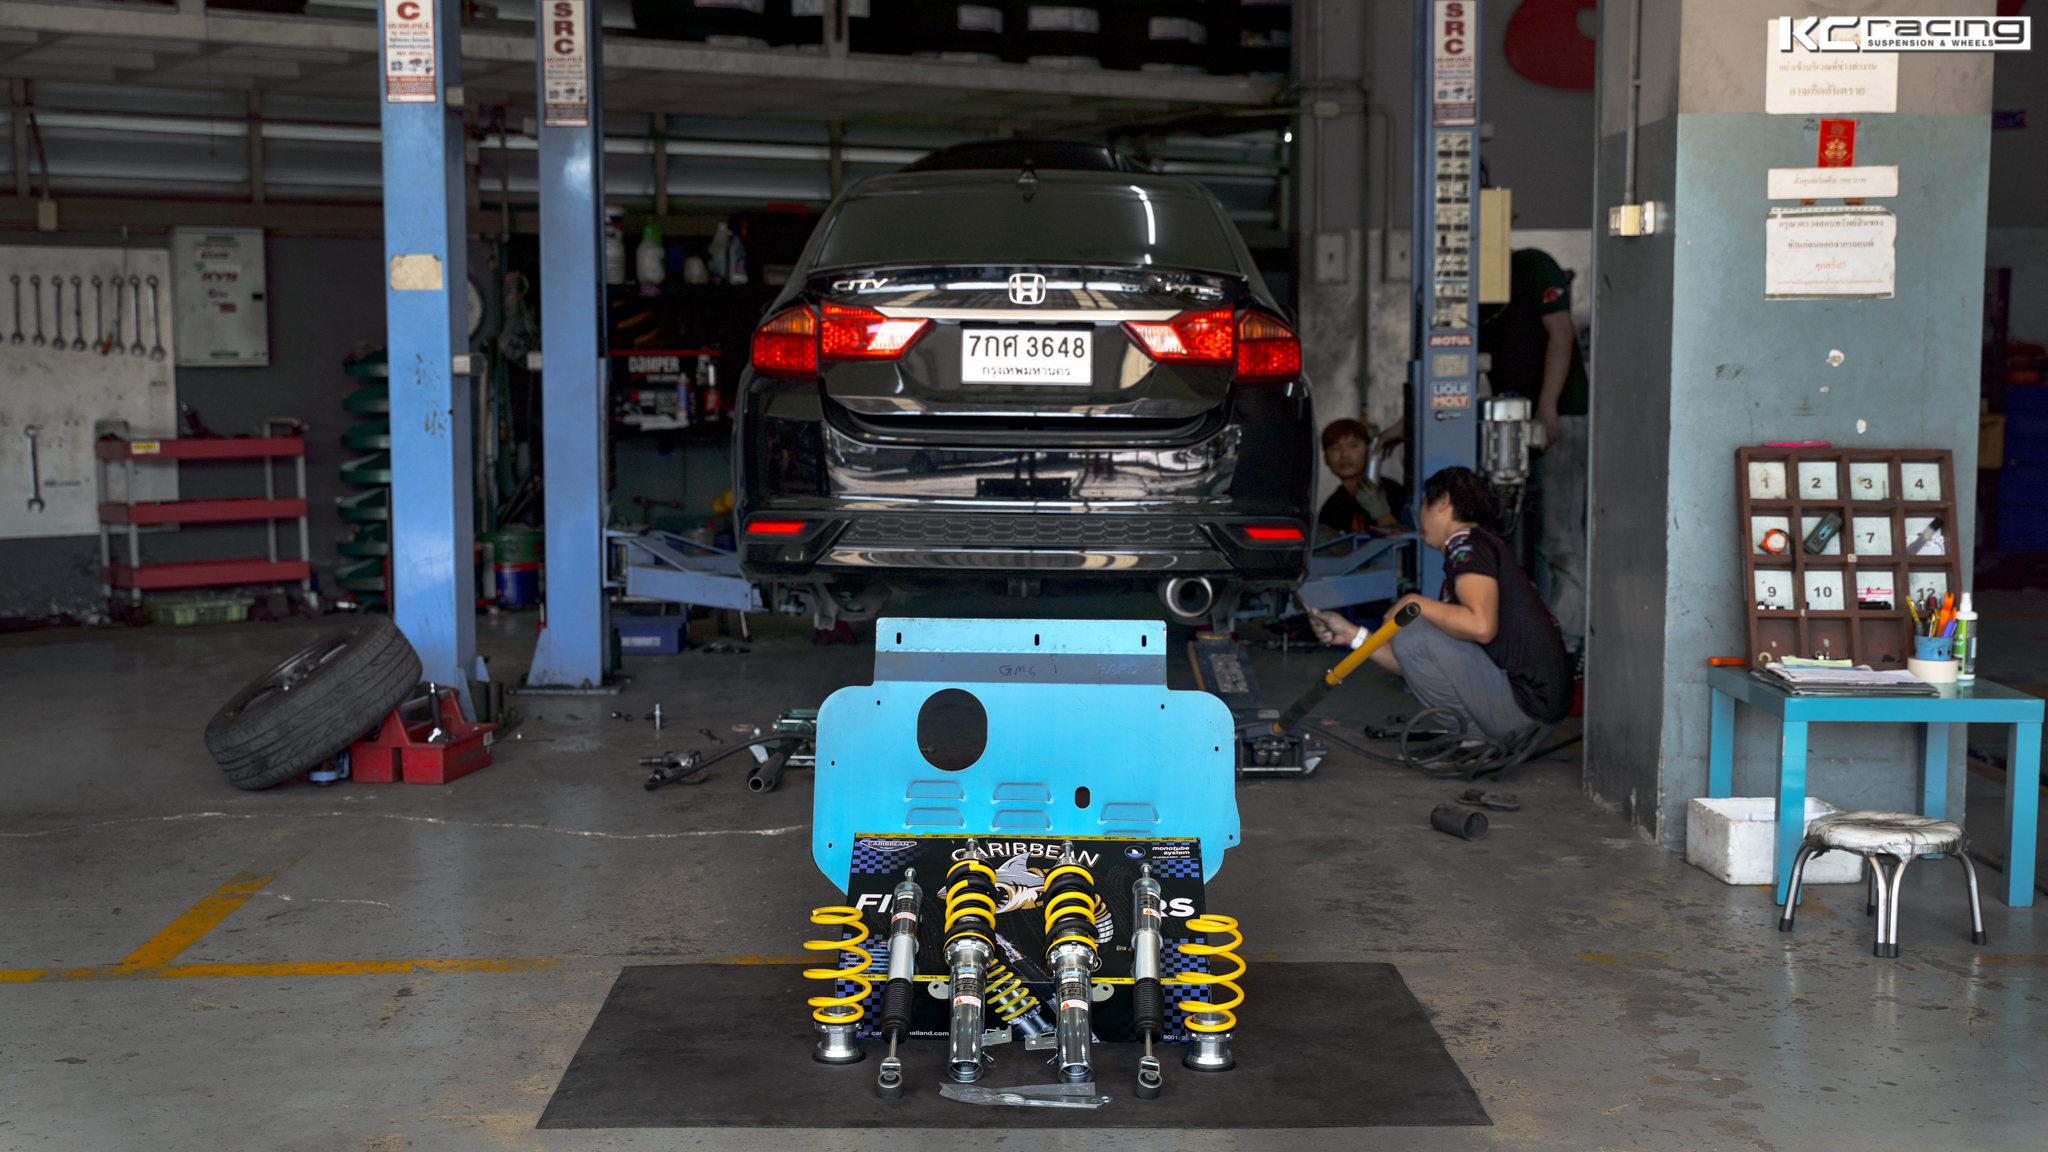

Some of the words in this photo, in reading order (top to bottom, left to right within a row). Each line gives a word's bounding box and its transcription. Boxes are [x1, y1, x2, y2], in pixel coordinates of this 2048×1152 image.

[553, 2, 575, 54] SRC
[1445, 2, 1465, 55] SRC
[1788, 82, 1866, 96] อาจเกิดอันตราย
[832, 278, 889, 291] CITY
[968, 334, 1019, 357] 7กศ
[1026, 336, 1085, 358] 3648
[982, 366, 1071, 379] กรุงเทพมหานคร
[1761, 477, 1769, 489] 1
[1811, 477, 1822, 489] 2
[1863, 478, 1873, 490] 3
[1914, 478, 1925, 490] 4
[1865, 532, 1875, 543] 7
[1766, 586, 1777, 598] 9
[1813, 586, 1832, 598] 10
[1916, 587, 1936, 600] 12
